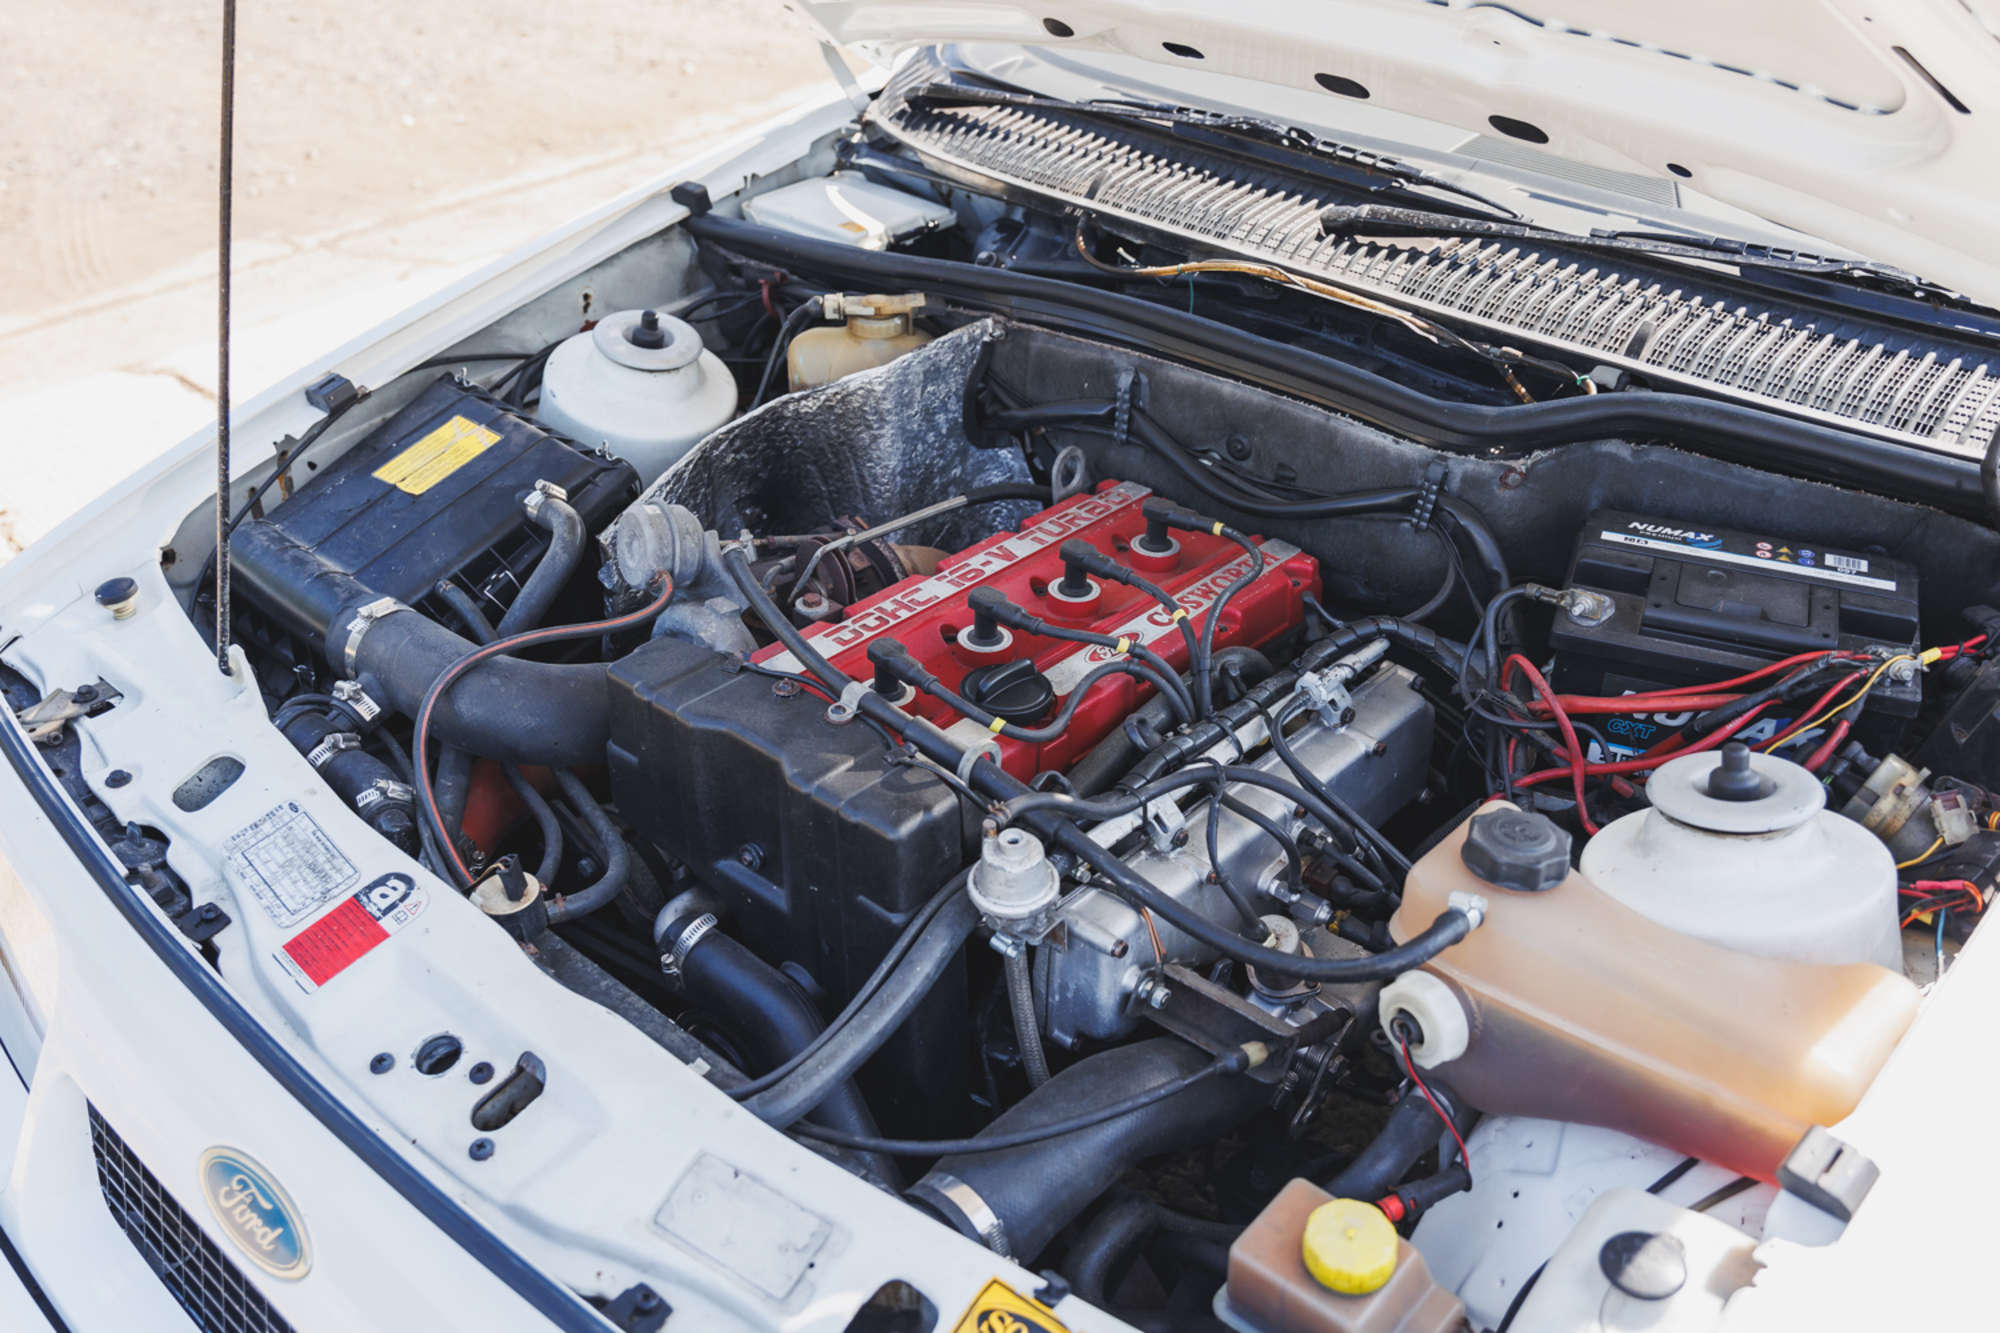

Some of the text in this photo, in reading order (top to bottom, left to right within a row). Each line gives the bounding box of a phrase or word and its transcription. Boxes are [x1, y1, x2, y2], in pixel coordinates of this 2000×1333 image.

[822, 490, 1131, 647] DOHC 16-V TURBO
[1628, 522, 1714, 541] NUMAX
[219, 1173, 284, 1251] Ford
